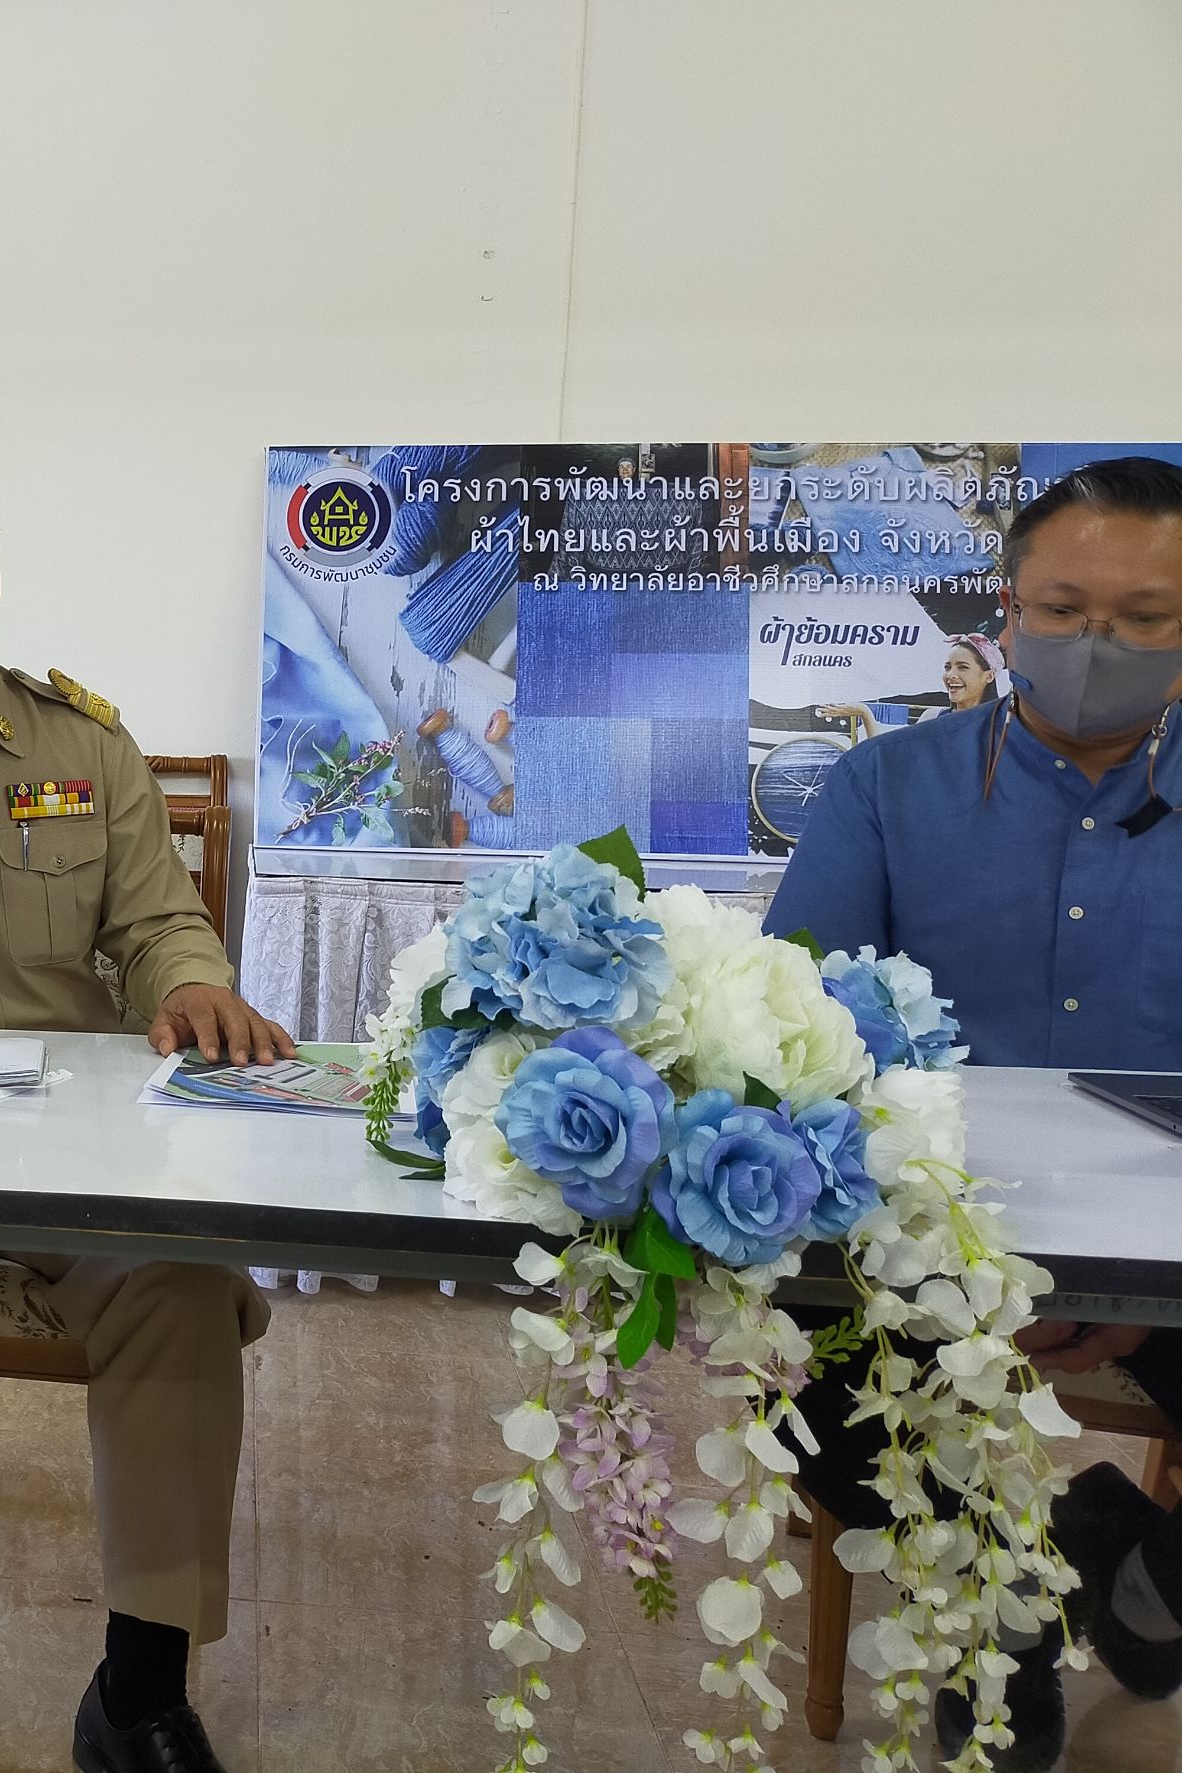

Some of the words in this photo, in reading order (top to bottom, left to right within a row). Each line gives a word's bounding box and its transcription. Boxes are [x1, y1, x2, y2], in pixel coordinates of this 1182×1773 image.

[400, 465, 1065, 502] โครงการพัฒนาและยกระดับผลิตภัณ
[470, 504, 861, 554] ผ้าไทยและผ้าพื้นเมือง
[878, 517, 1004, 555] จังหวัด
[279, 544, 398, 583] กรมการพัฒนาชุมชน
[533, 572, 559, 592] ณ
[759, 616, 921, 666] ผ้าย้อมคราม
[792, 653, 853, 668] สกลนคร
